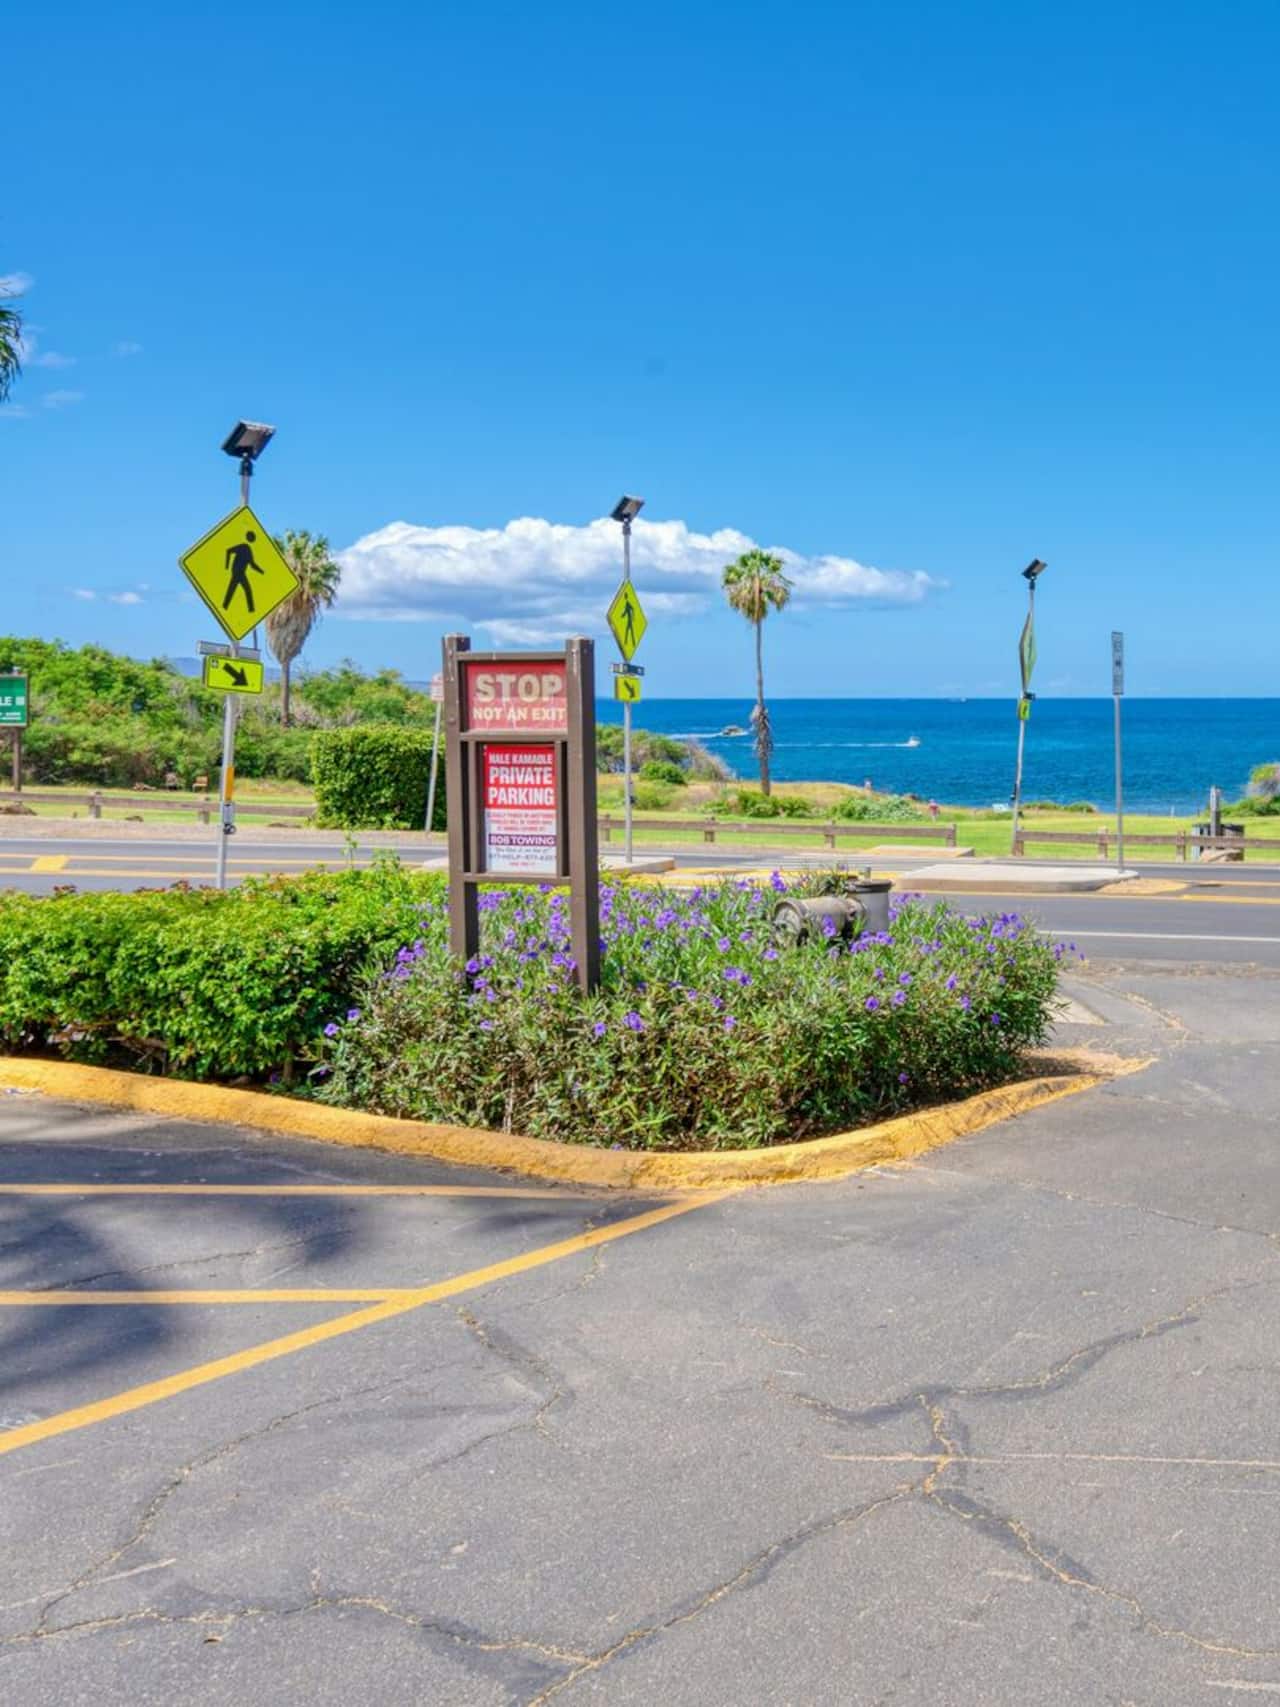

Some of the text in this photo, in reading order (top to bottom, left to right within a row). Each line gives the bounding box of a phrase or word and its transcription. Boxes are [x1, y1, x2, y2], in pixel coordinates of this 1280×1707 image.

[475, 673, 562, 703] STOP
[473, 707, 566, 720] NOT AN EXIT
[489, 766, 552, 785] PRIVATE
[488, 787, 555, 806] PARKING
[511, 836, 555, 845] TOWING
